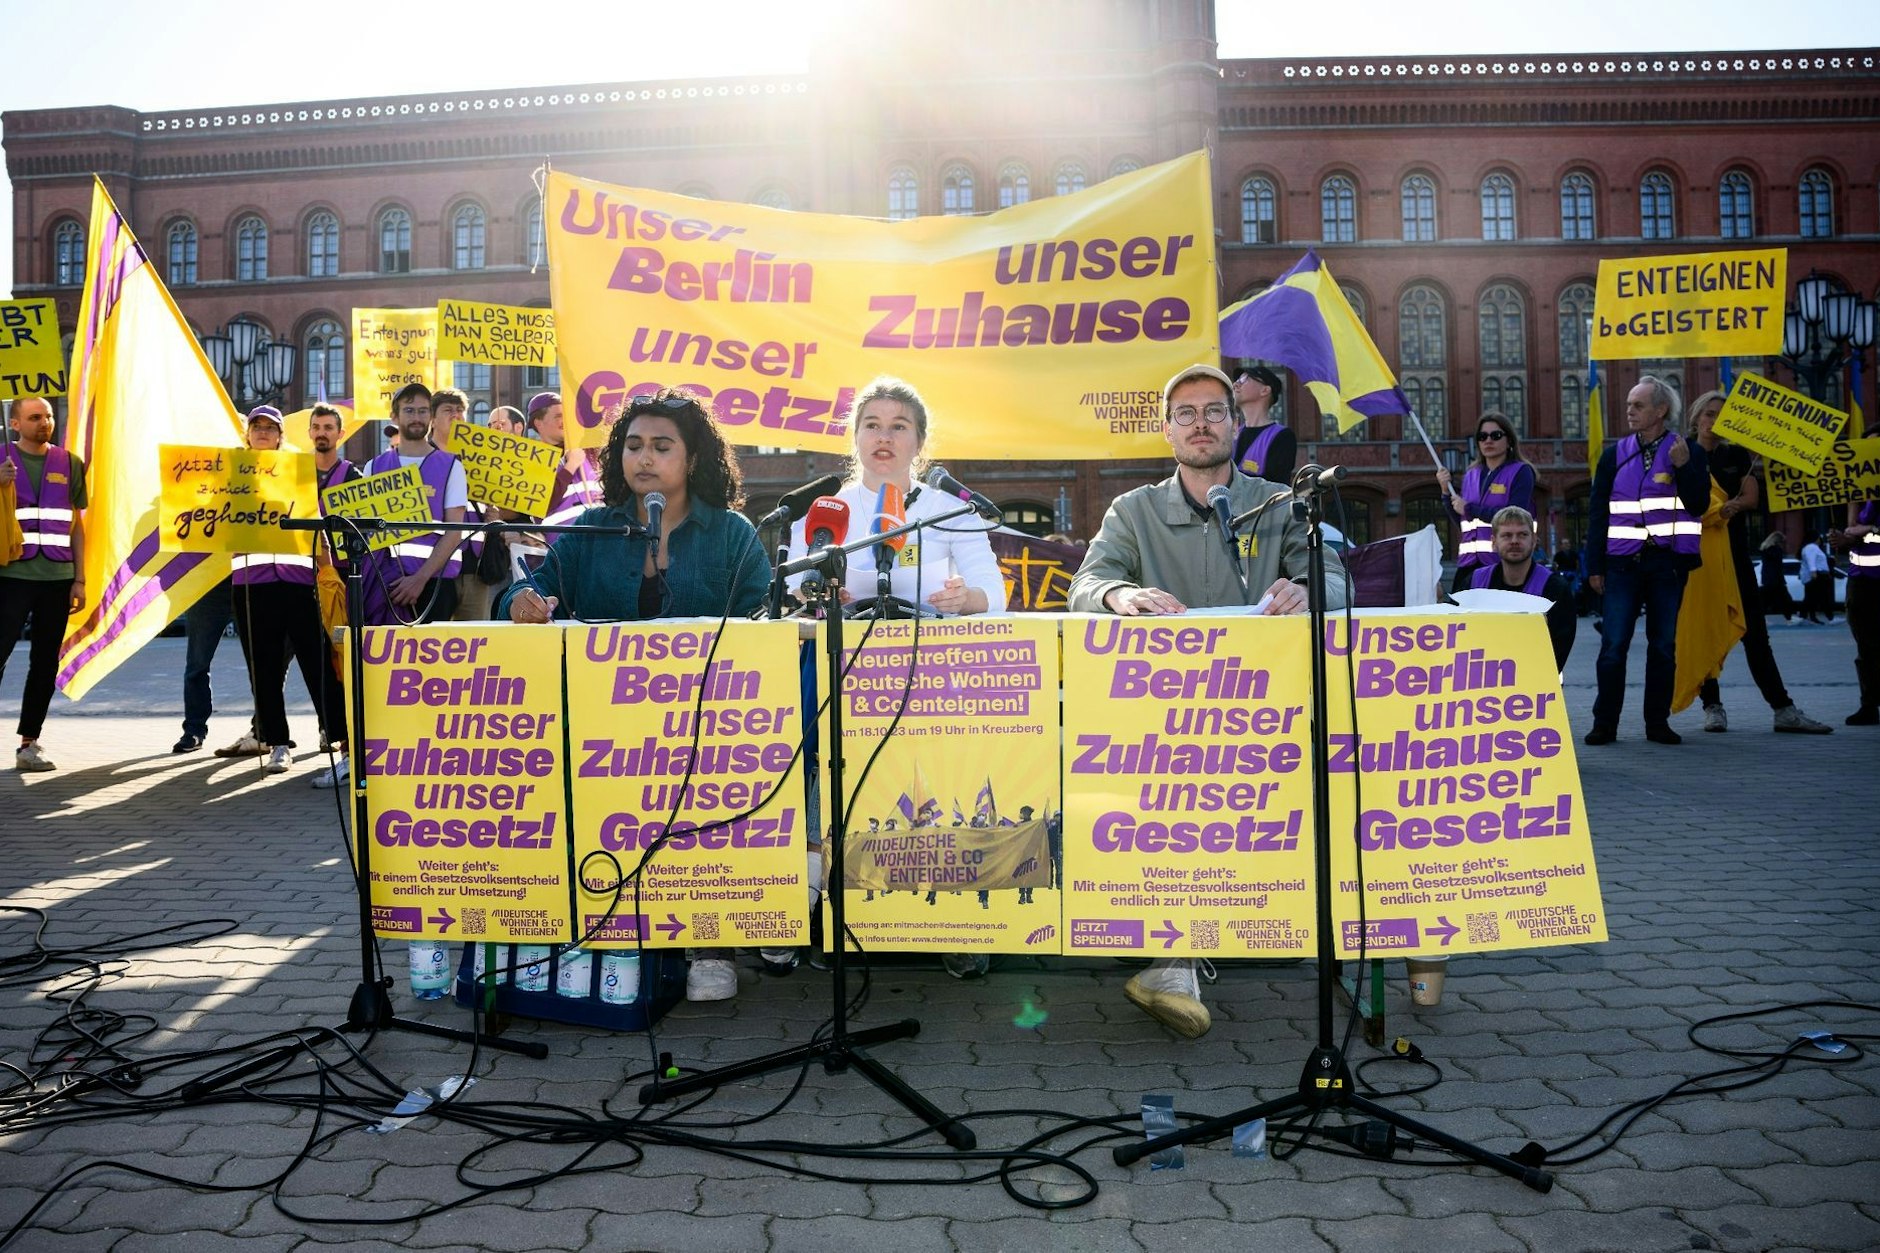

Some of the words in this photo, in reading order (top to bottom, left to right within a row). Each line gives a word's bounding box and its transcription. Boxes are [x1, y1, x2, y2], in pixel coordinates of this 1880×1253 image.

[561, 188, 747, 242] Unser
[994, 234, 1194, 286] unser
[607, 246, 813, 303] Berlin
[1617, 258, 1775, 299] ENTEIGNEN
[862, 291, 1190, 349] Zuhause
[444, 323, 481, 339] MAN
[408, 346, 431, 364] gut
[629, 327, 817, 379] unser
[2, 370, 66, 395] TUN
[378, 372, 423, 383] werden
[575, 370, 856, 437] Getz!
[1101, 391, 1164, 405] DEUTSCH
[1737, 379, 1843, 434] ENTEIGNUNG
[1094, 405, 1159, 419] WOHNEN
[1110, 420, 1164, 433] ENTEIG
[1768, 415, 1792, 431] man
[173, 452, 224, 482] jetzt
[239, 462, 280, 477] wird
[1769, 462, 1838, 482] MUS
[328, 469, 414, 509] ENTEIGNEN
[917, 621, 1013, 638] anmelden:
[1084, 619, 1228, 655] Unser
[1324, 619, 1466, 656] Unser
[363, 629, 488, 664] Unser
[585, 626, 719, 662] Unser
[845, 647, 988, 669] Neuentreffen
[992, 646, 1032, 663] von
[611, 660, 761, 705] Berlin
[843, 673, 945, 692] Deutsche
[950, 671, 1036, 690] Wohnen
[1109, 657, 1270, 699] Berlin
[1356, 649, 1516, 698] Berlin
[386, 666, 526, 706] Berlin
[854, 695, 871, 713] &
[874, 695, 903, 713] Co
[909, 694, 1024, 715] enteignen!
[1415, 692, 1556, 731] unser
[435, 713, 556, 740] unser
[663, 706, 794, 738] unser
[860, 726, 906, 736] 18.1023
[909, 728, 926, 736] um
[930, 726, 942, 736] 19
[945, 724, 965, 735] Uhr
[969, 725, 979, 734] in
[982, 723, 1044, 735] Kreuzberg
[1165, 706, 1304, 735] unser
[365, 738, 555, 777] Zuhause
[578, 737, 793, 778] Zuhause
[1071, 733, 1302, 774] Zuhause
[1328, 727, 1561, 773] Zuhause
[415, 784, 535, 810] unser
[641, 781, 772, 811] unser
[1138, 782, 1280, 811] unser
[1397, 766, 1542, 808] unser
[375, 810, 557, 849] Gesetz!
[599, 808, 796, 852] Gesetz!
[1092, 810, 1304, 853] Gesetz!
[1354, 794, 1572, 851] Gesetz!
[882, 833, 956, 852] DEUTSCHE
[418, 860, 458, 871] Weiter
[463, 860, 500, 874] geht's:
[874, 850, 939, 866] WOHNEN
[944, 850, 956, 864] &
[962, 849, 983, 864] CO
[1408, 862, 1458, 875] Weiter
[1462, 858, 1509, 874] geht's:
[383, 872, 417, 884] einem
[420, 873, 560, 886] Gesetzesvolksentscheid
[645, 863, 688, 875] Weiter
[692, 863, 733, 877] geht's:
[890, 867, 978, 883] ENTEIGNEN
[1142, 867, 1188, 879] Weiter
[1193, 867, 1236, 881] geht's:
[1366, 880, 1409, 892] einem
[1412, 864, 1585, 890] Gesetzesvolksentscheid
[585, 878, 605, 889] Mit
[647, 874, 798, 889] Gesetzesvolksentscheid
[1073, 880, 1096, 892] Mit
[1099, 881, 1139, 892] einem
[1143, 879, 1305, 893] Gesetzesvolksentscheid
[393, 885, 434, 896] endlich
[438, 887, 455, 896] zur
[459, 886, 527, 901] Umsetzung!
[666, 893, 684, 901] zur
[690, 889, 764, 902] Umsetzung!
[1110, 894, 1160, 906] endlich
[1164, 896, 1185, 906] zur
[1189, 894, 1268, 908] Umsetzung!
[1380, 892, 1431, 906] endlich
[1435, 891, 1457, 902] zur
[1461, 881, 1547, 899] Umsetzung!
[371, 908, 392, 917] ETZT
[504, 910, 548, 919] DEUTSCHE
[587, 917, 617, 927] JEZT
[739, 911, 786, 921] DEUTSCHE
[1516, 917, 1566, 929] WOHNEN
[1570, 916, 1578, 925] &
[1581, 914, 1596, 924] CO
[1521, 905, 1575, 919] DEUTSCHE
[371, 919, 413, 930] PENDEN!
[500, 918, 538, 927] WOHNEN
[542, 919, 549, 927] &
[551, 919, 564, 927] CO
[509, 927, 558, 936] ENTEIGNEN
[735, 920, 777, 930] WOHNEN
[780, 920, 788, 929] &
[790, 919, 803, 929] CO
[1074, 922, 1109, 932] JETZT
[1241, 919, 1292, 929] DEUTSCHE
[1344, 923, 1381, 935] JEZT
[1530, 925, 1591, 939] ENTEIGNEN
[745, 930, 797, 939] ENTEIGNEN
[1074, 935, 1133, 945] SPENDEN!
[1236, 929, 1281, 939] WOHNEN
[1285, 930, 1292, 938] &
[1295, 929, 1309, 939] CO
[1247, 939, 1302, 949] ENTEIGNEN
